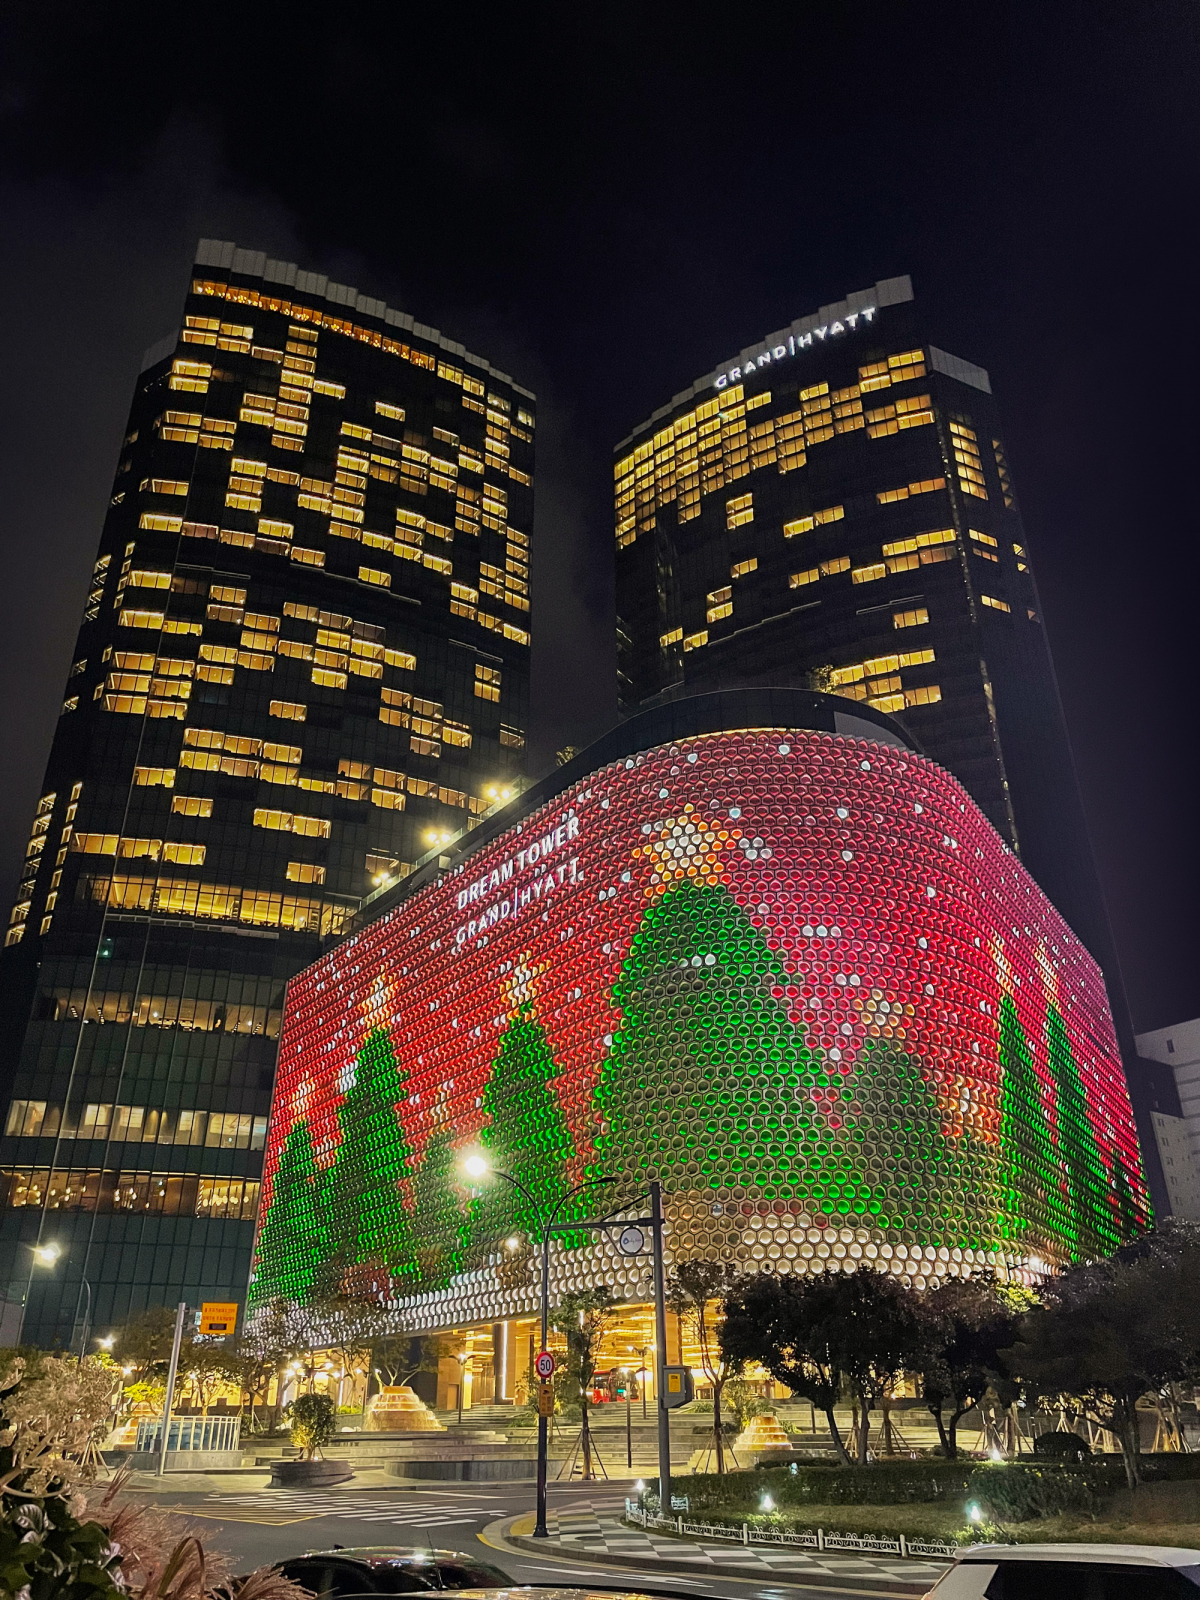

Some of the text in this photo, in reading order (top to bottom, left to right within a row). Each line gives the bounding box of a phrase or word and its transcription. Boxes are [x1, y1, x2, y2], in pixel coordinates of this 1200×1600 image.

[713, 307, 877, 390] GRAND HYATT
[456, 856, 580, 945] GRAND HYATT
[457, 816, 580, 911] DREAM TOWER
[540, 1359, 551, 1372] 50
